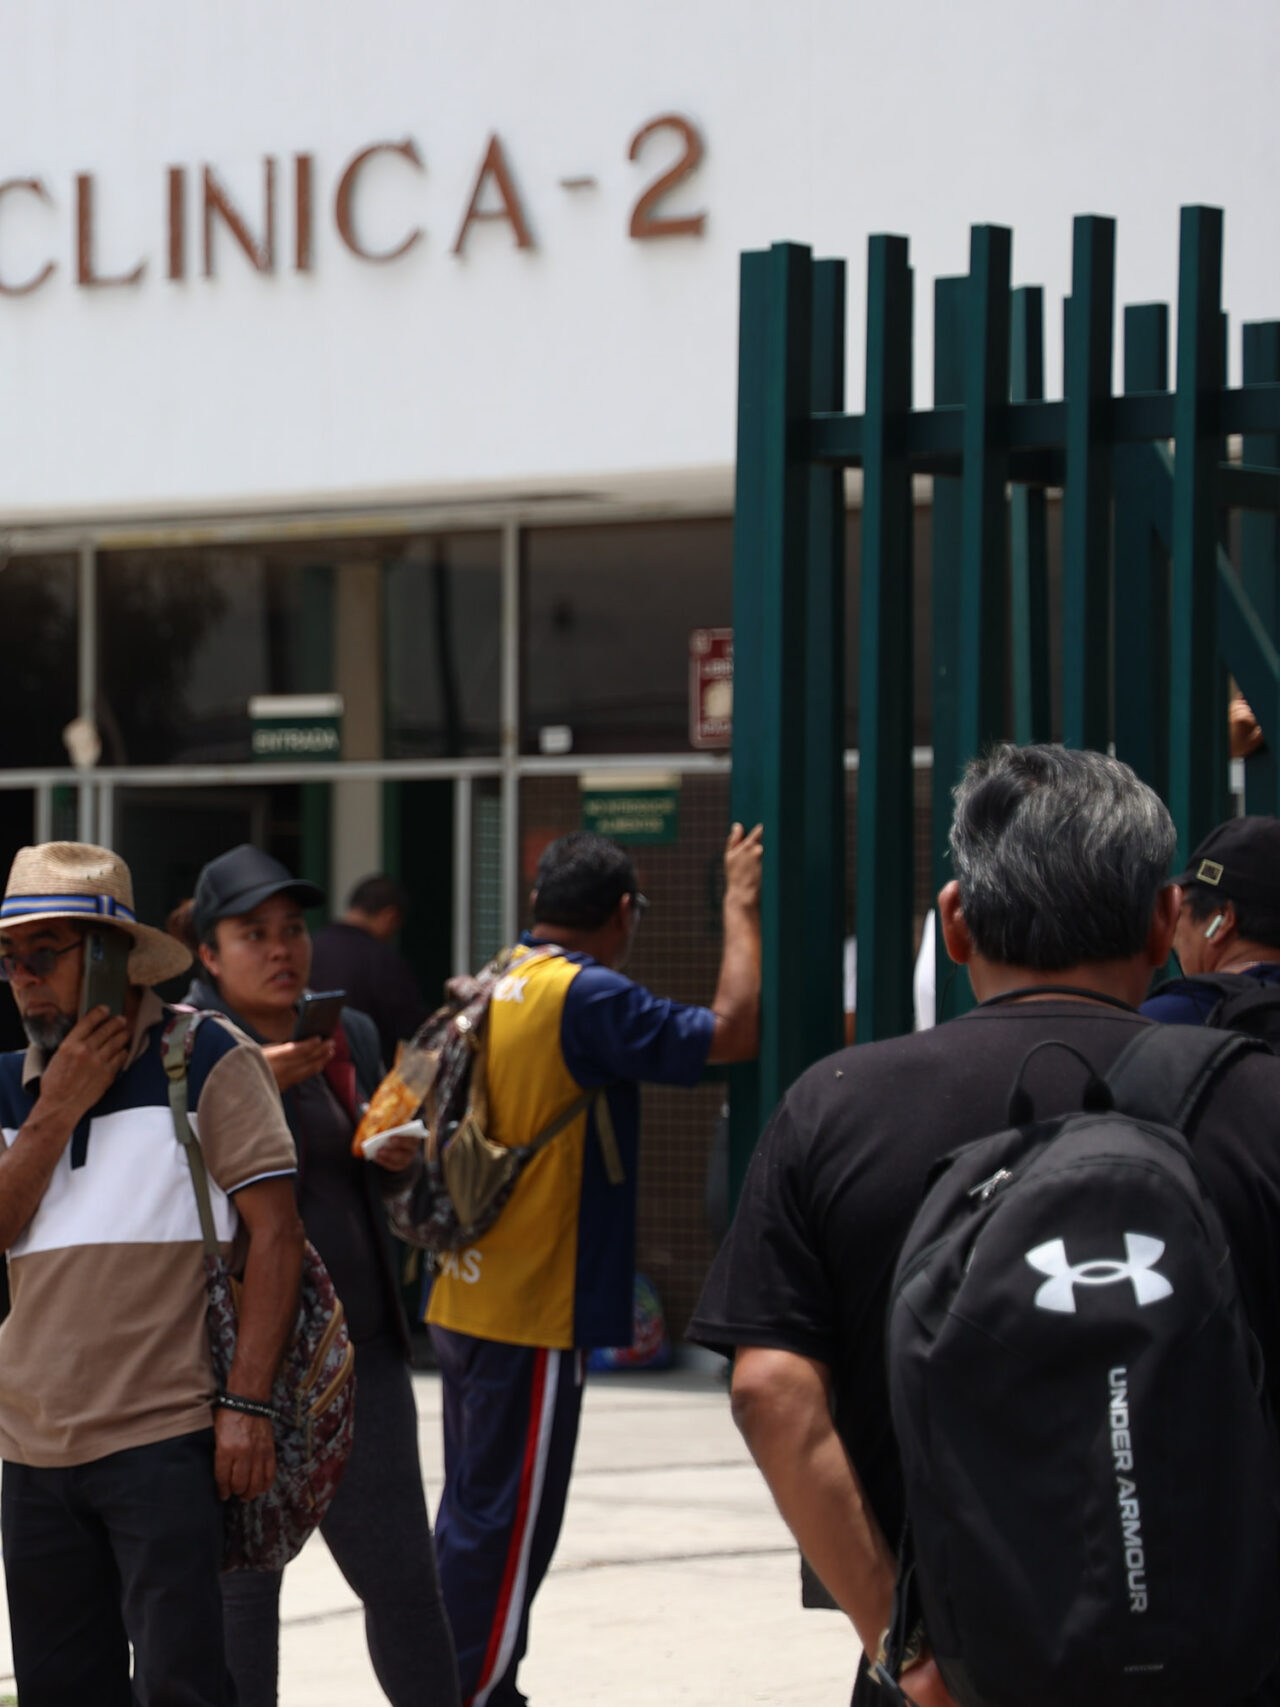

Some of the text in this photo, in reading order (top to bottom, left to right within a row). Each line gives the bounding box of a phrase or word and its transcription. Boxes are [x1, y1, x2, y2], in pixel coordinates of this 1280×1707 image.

[252, 728, 339, 754] ENTRADA
[1108, 1367, 1148, 1613] UNDER ARMOUR
